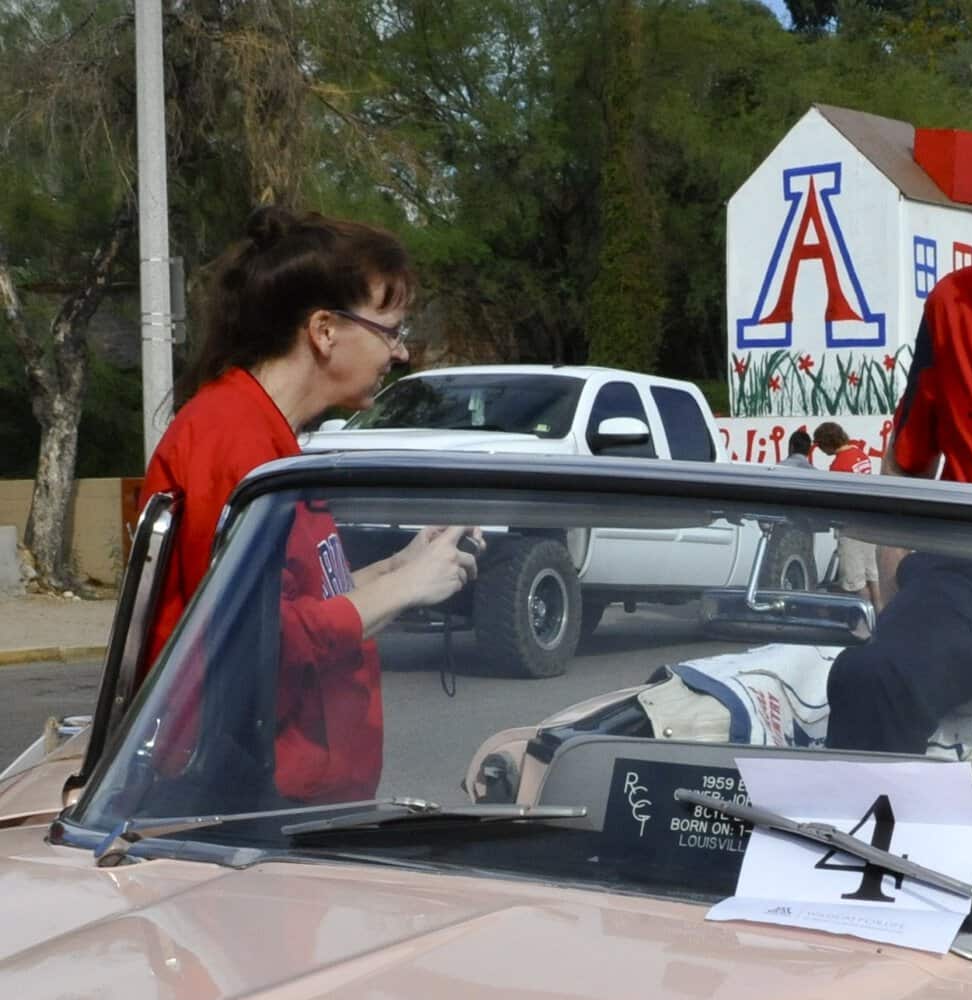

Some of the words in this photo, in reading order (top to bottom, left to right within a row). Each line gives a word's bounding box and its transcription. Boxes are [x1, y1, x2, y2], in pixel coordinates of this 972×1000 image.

[737, 162, 886, 349] A
[702, 775, 734, 790] 1959
[670, 818, 708, 833] BORN
[712, 822, 734, 836] ON:
[814, 794, 908, 902] 4
